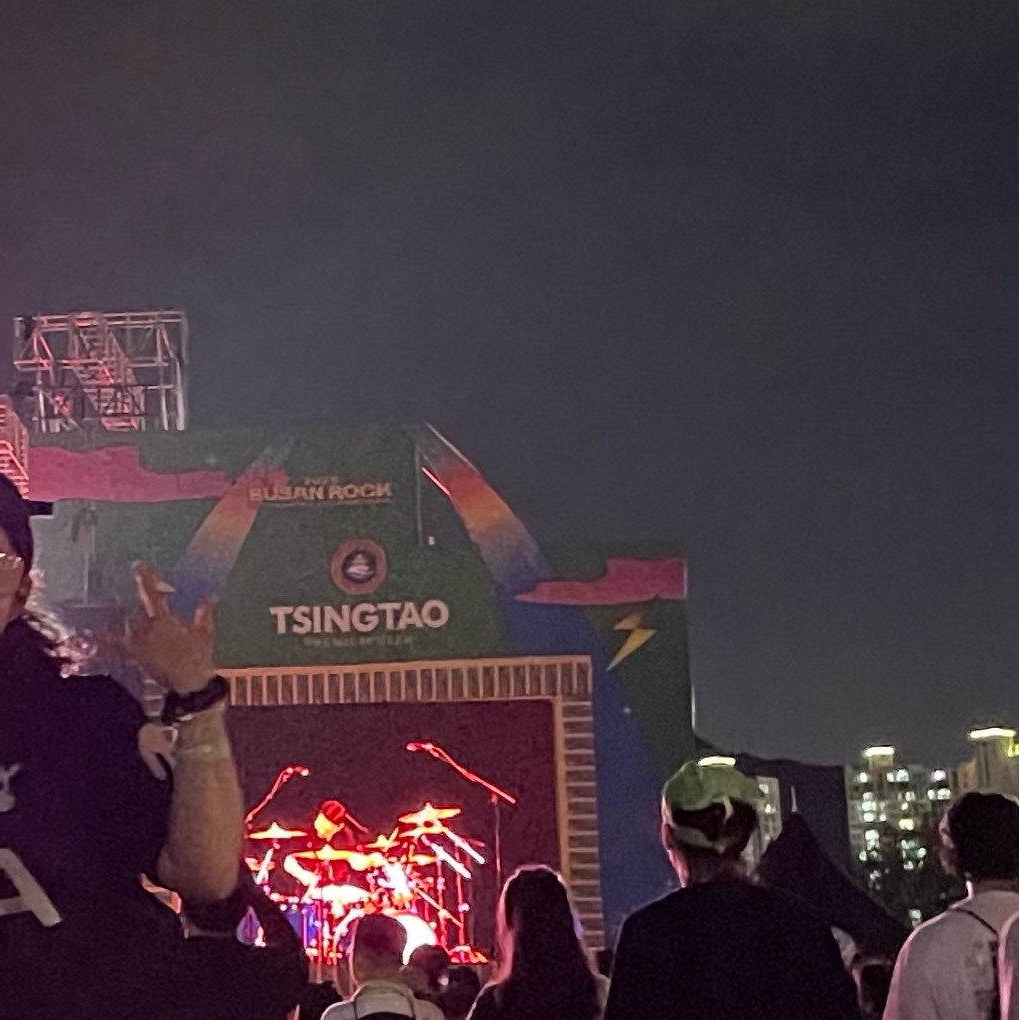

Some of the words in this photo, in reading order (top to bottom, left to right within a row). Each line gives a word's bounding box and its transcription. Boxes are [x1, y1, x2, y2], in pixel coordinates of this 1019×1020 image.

[249, 485, 324, 501] BUSAN
[328, 482, 392, 499] ROCK
[269, 599, 449, 634] TSINGTAO
